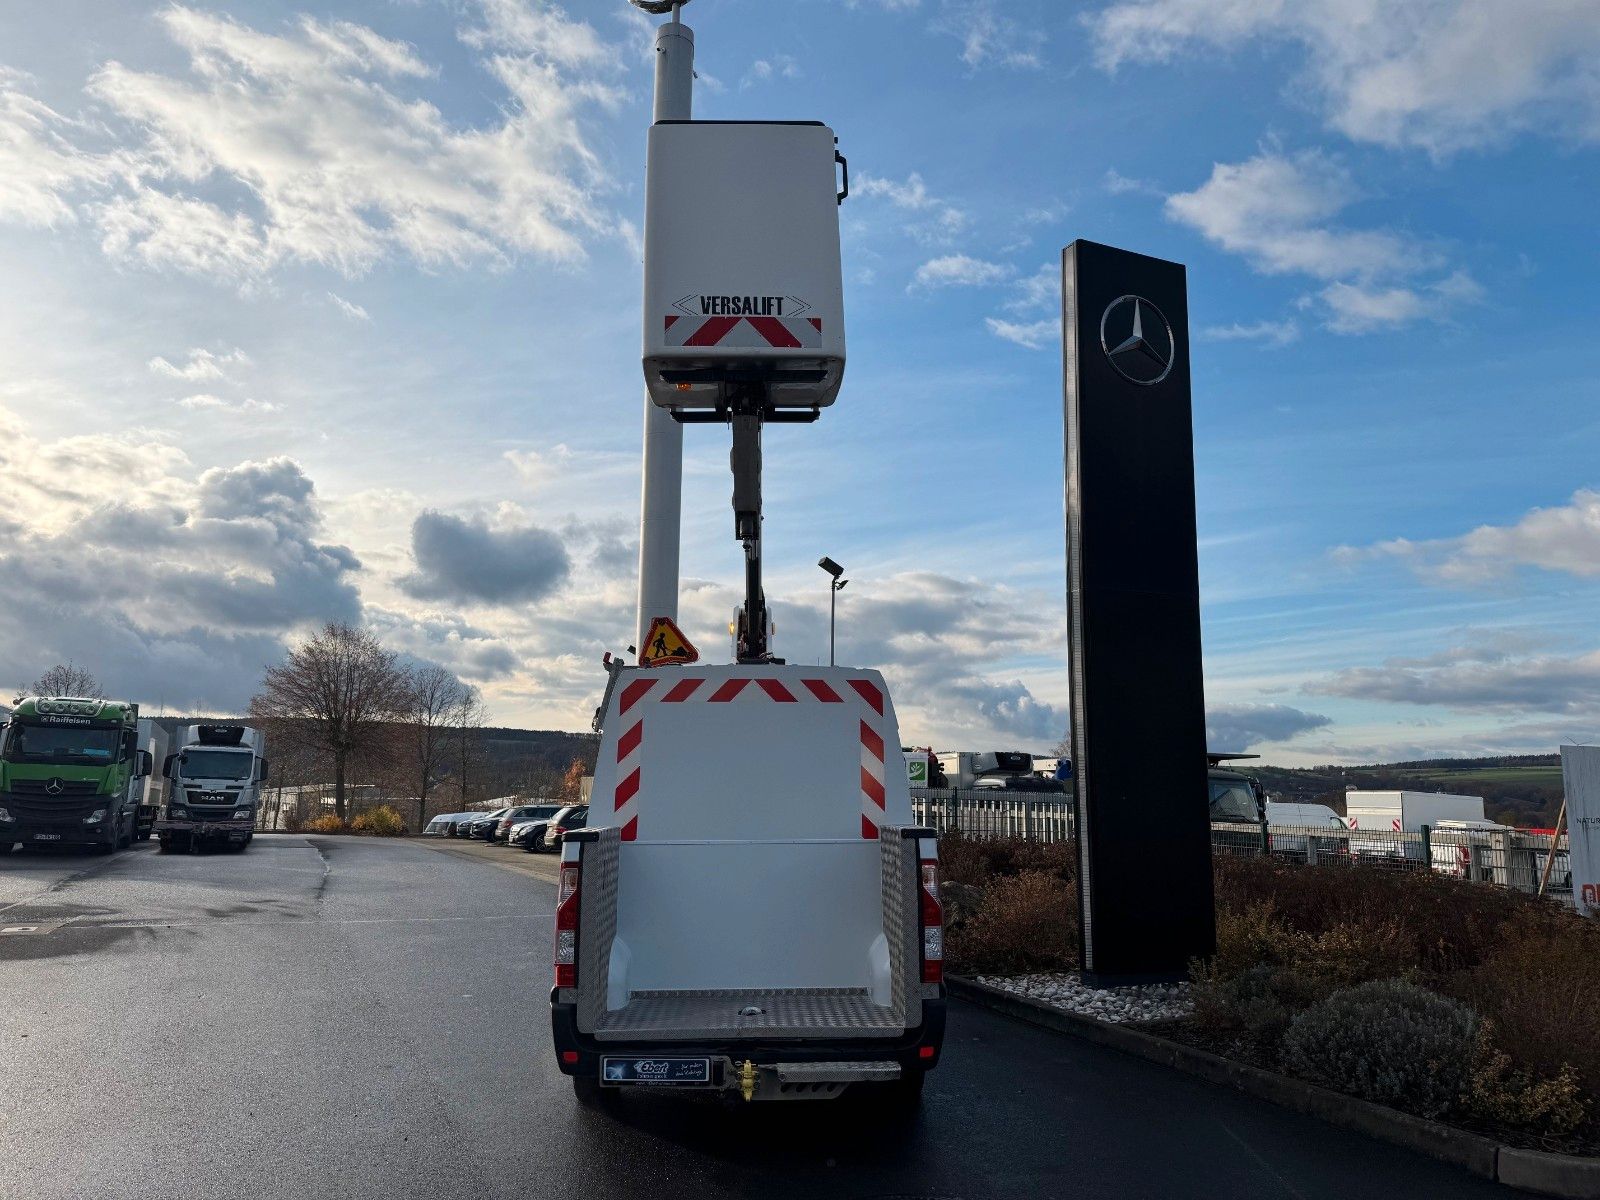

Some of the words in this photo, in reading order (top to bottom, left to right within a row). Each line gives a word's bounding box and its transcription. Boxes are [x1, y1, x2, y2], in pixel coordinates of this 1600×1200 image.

[700, 296, 784, 315] VERSALIFT
[49, 715, 91, 725] Raiffeisen
[641, 1060, 669, 1074] Ebert
